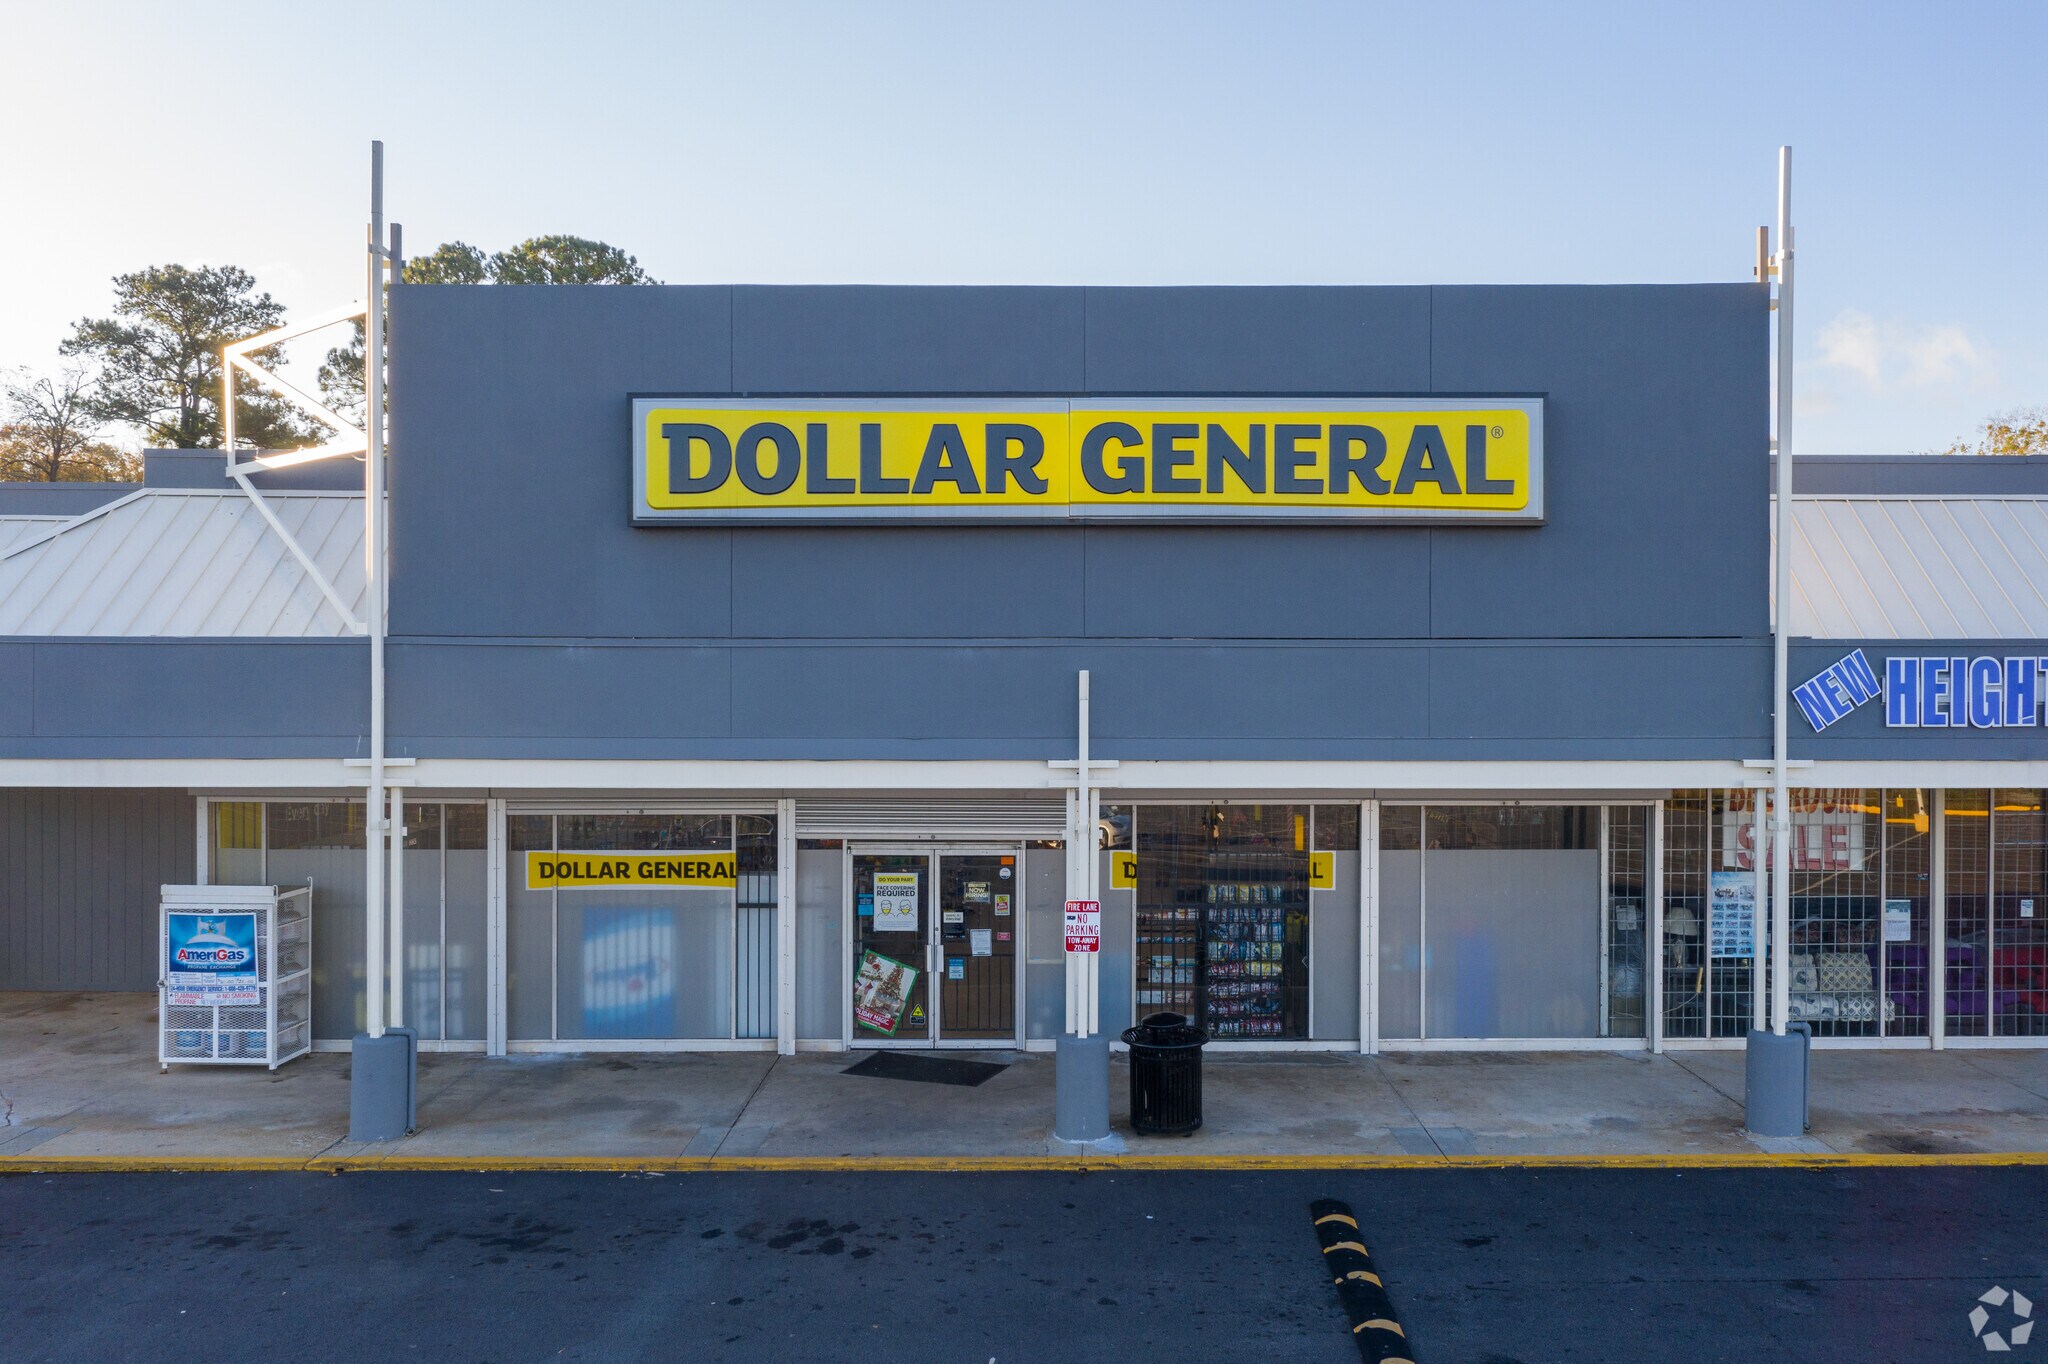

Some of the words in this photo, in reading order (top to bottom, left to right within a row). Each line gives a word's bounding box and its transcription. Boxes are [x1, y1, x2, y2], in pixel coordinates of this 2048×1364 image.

[661, 422, 1049, 495] DOLLAR
[1081, 421, 1515, 495] GENERAL
[1791, 647, 1882, 733] NEW
[1886, 656, 2048, 728] HEIGH
[538, 861, 631, 879] DOLLAR
[1067, 903, 1080, 911] FIRE
[1082, 903, 1097, 911] LANE
[1077, 913, 1088, 924] NO
[1066, 925, 1099, 935] PARKING
[177, 949, 245, 960] AmeriGas
[873, 1014, 890, 1026] MAGIC
